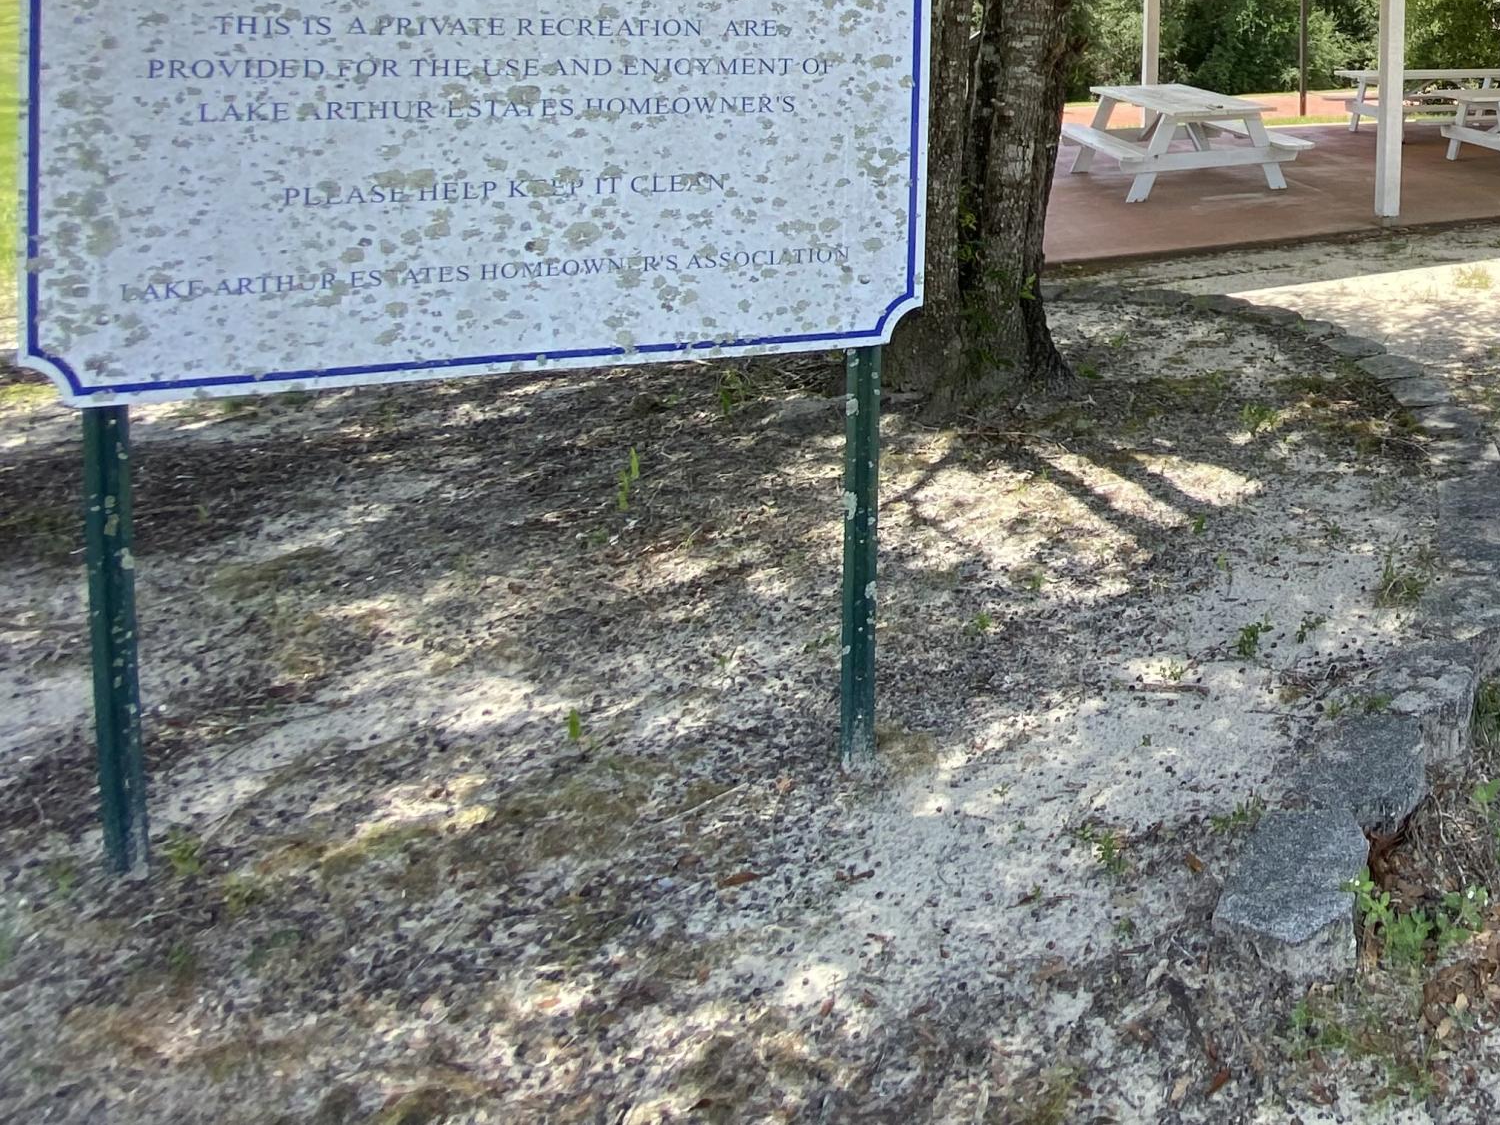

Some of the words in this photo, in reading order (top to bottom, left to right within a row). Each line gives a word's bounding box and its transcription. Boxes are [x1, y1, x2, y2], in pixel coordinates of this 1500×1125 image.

[214, 14, 291, 36] THIS
[303, 15, 332, 36] IS
[346, 16, 368, 35] A
[374, 16, 506, 37] PRIVATE
[517, 17, 703, 38] RECREATION
[146, 58, 325, 79] PROVIDED
[337, 58, 399, 78] FOR
[409, 58, 473, 77] THE
[483, 58, 541, 77] USE
[546, 58, 612, 76] AND
[623, 57, 794, 77] ENJOYMENT
[802, 57, 834, 75] OF
[199, 102, 290, 123] LAKE
[586, 95, 796, 116] HOMEOWNER'S
[417, 181, 498, 202] HELP
[507, 178, 584, 198] KEP
[596, 176, 624, 195] IT
